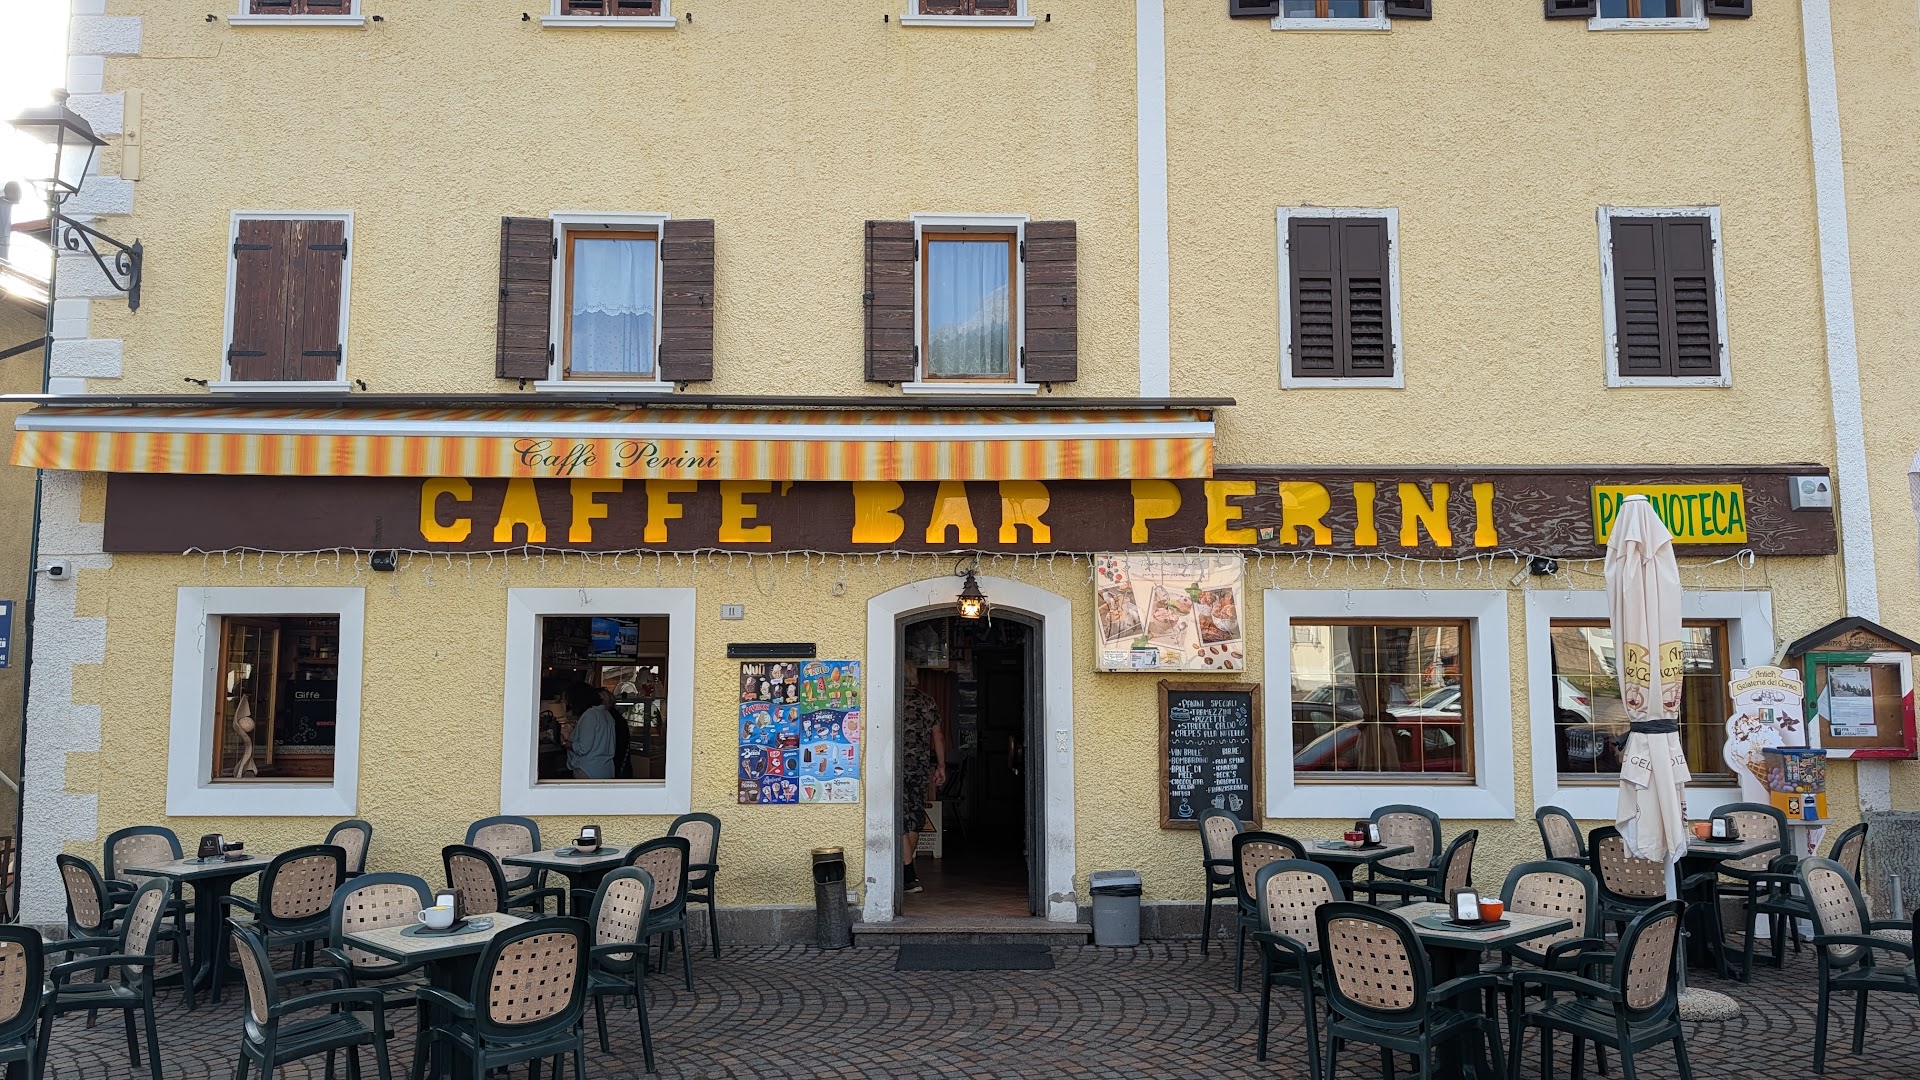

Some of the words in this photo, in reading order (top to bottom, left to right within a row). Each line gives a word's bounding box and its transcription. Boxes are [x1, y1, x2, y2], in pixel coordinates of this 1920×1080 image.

[514, 439, 597, 475] Caffè
[615, 441, 720, 468] Perini
[852, 481, 1051, 543] BAR
[1131, 480, 1498, 547] PERINI
[1737, 680, 1766, 690] Gelateria
[1181, 699, 1204, 708] PANINI
[1195, 715, 1226, 723] PIZZETTE
[1215, 722, 1236, 730] CALDO
